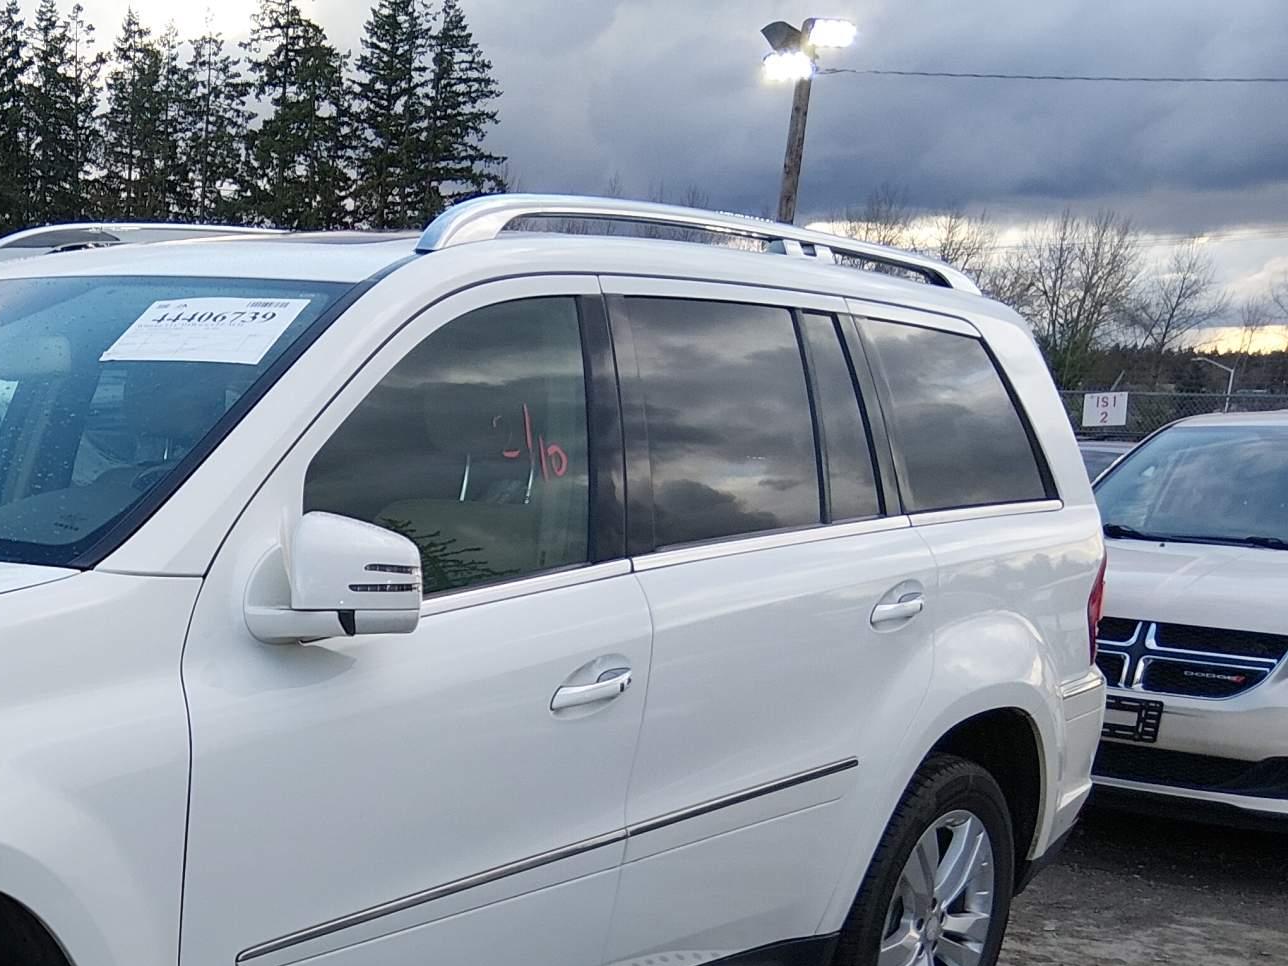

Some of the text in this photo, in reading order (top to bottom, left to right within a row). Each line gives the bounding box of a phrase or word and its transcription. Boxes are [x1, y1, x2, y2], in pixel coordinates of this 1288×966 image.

[151, 310, 278, 325] 44406739
[1100, 411, 1109, 423] 2
[1183, 671, 1234, 680] DODGE
